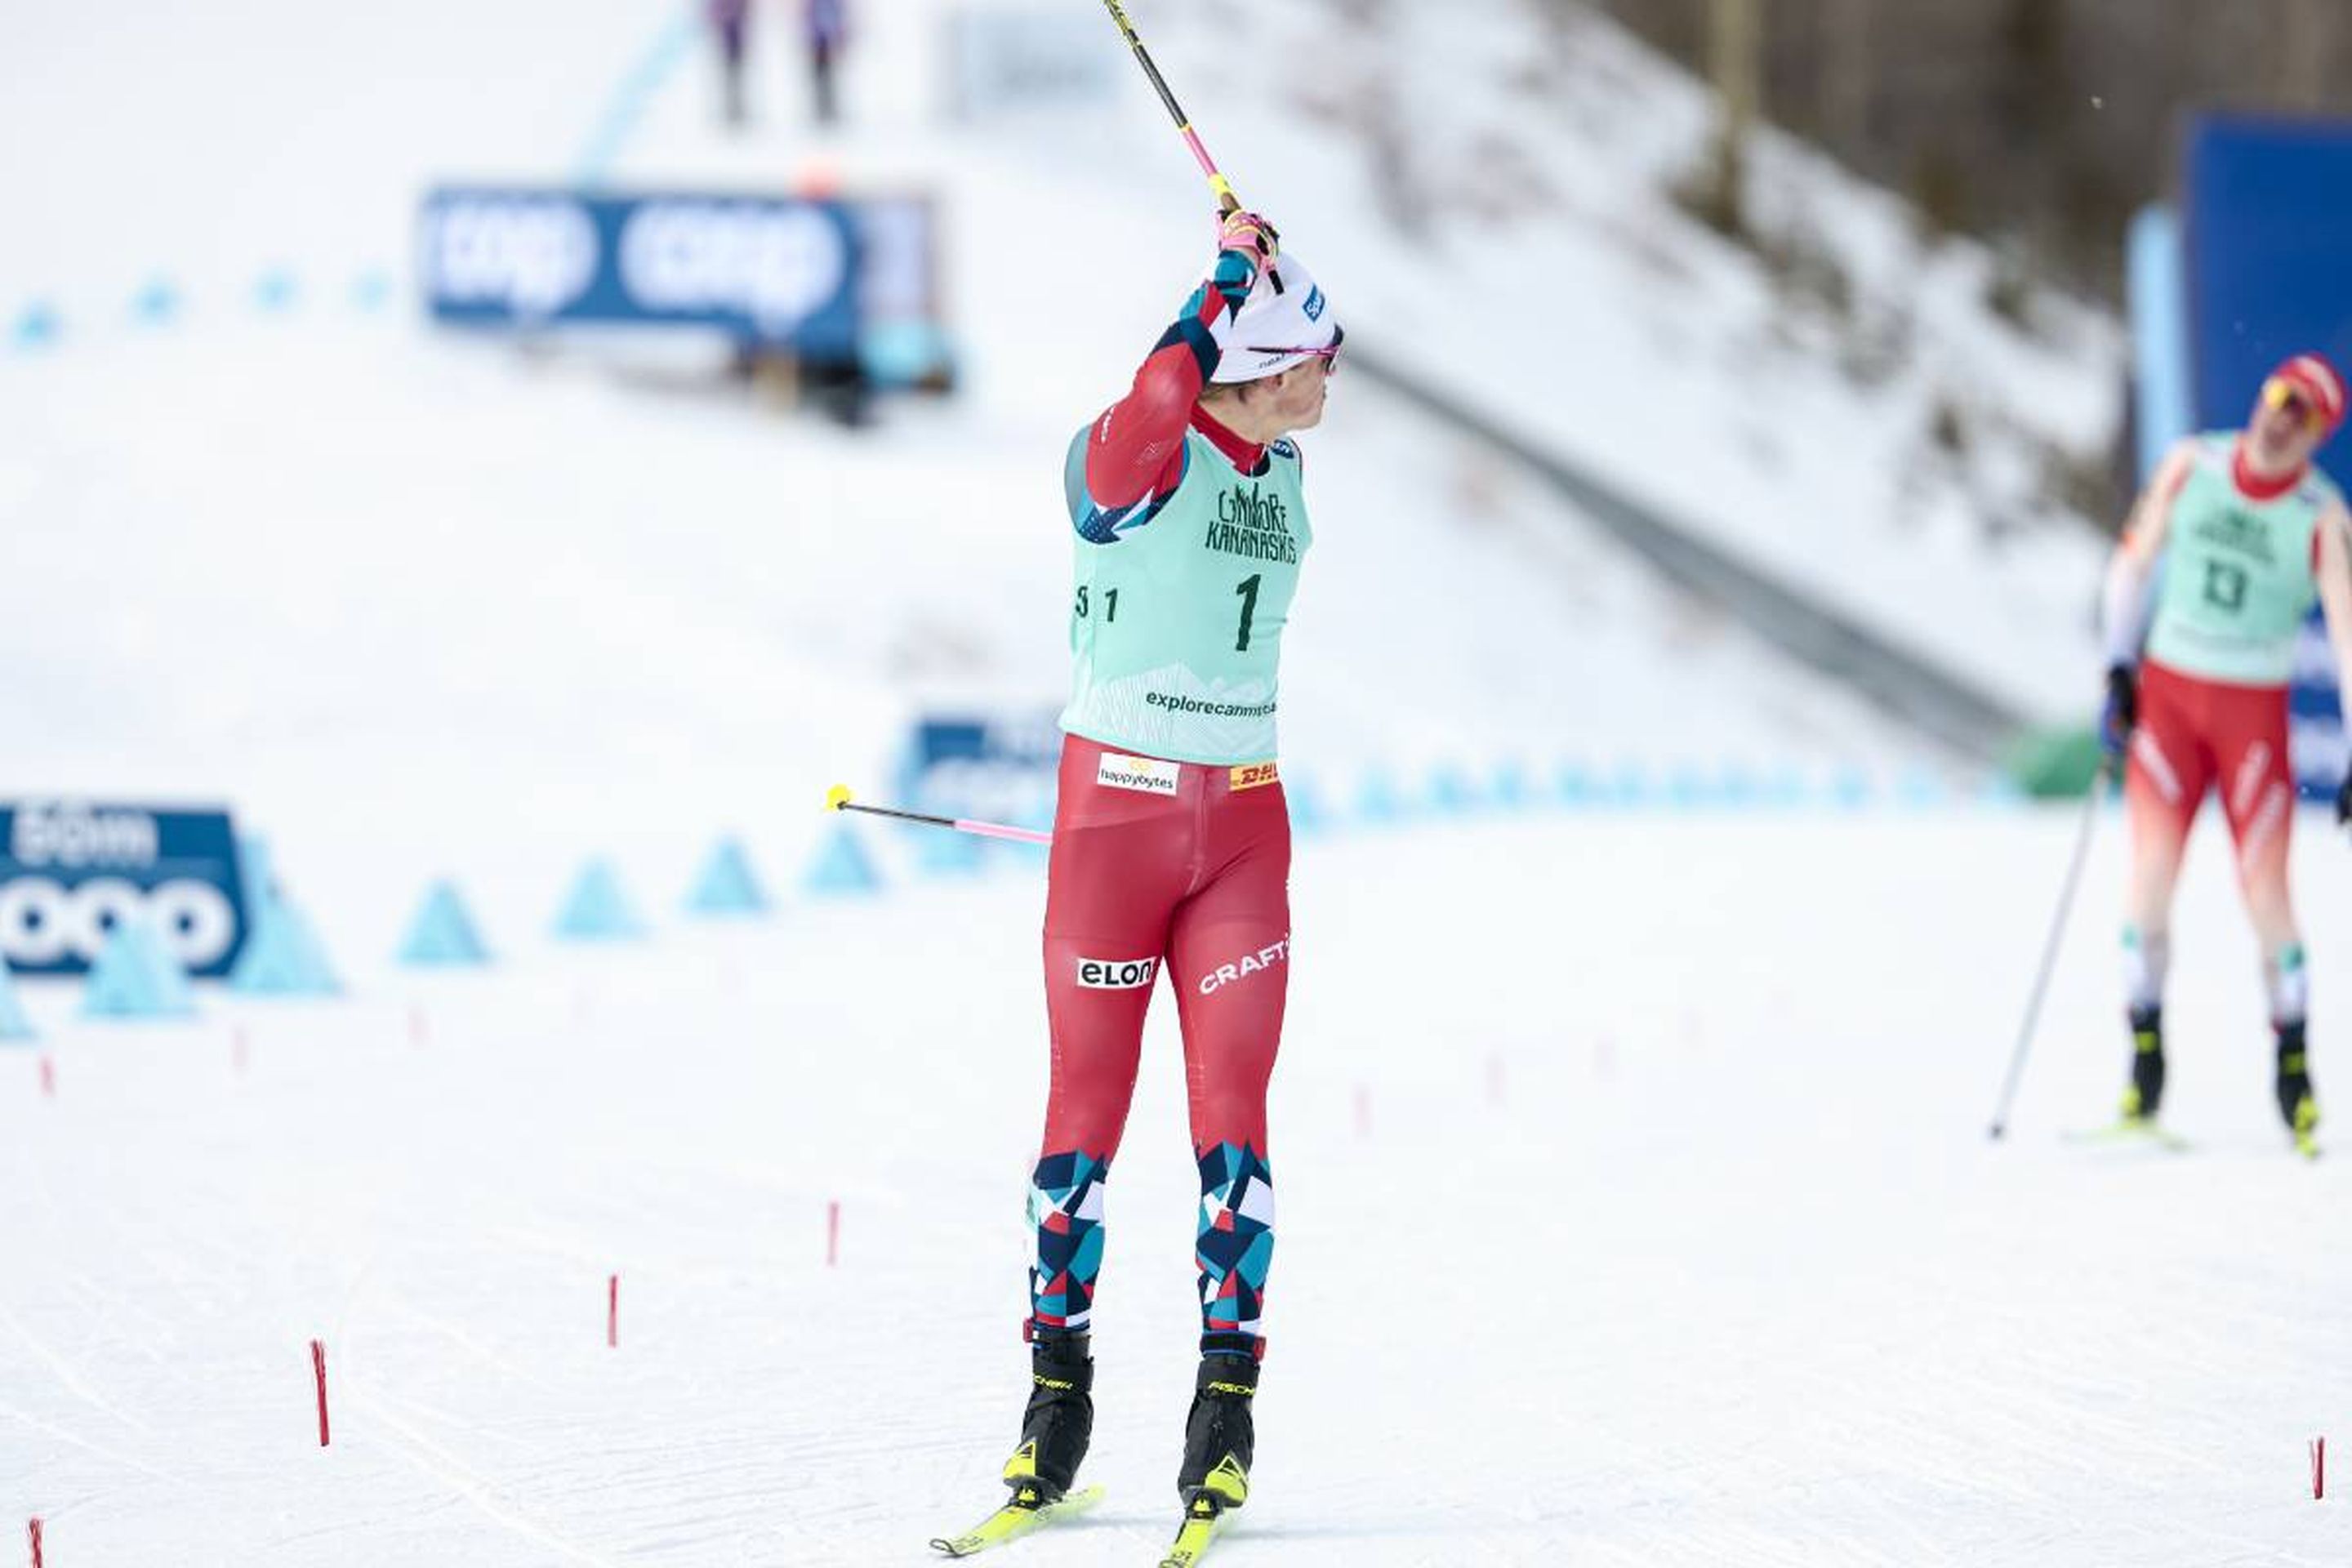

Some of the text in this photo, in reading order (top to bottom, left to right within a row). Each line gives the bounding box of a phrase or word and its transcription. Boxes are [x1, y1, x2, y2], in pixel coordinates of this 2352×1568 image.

[1105, 587, 1117, 622] 1
[1236, 573, 1261, 652] 1
[1100, 768, 1174, 790] happybytes
[1199, 941, 1286, 995] CRAFT
